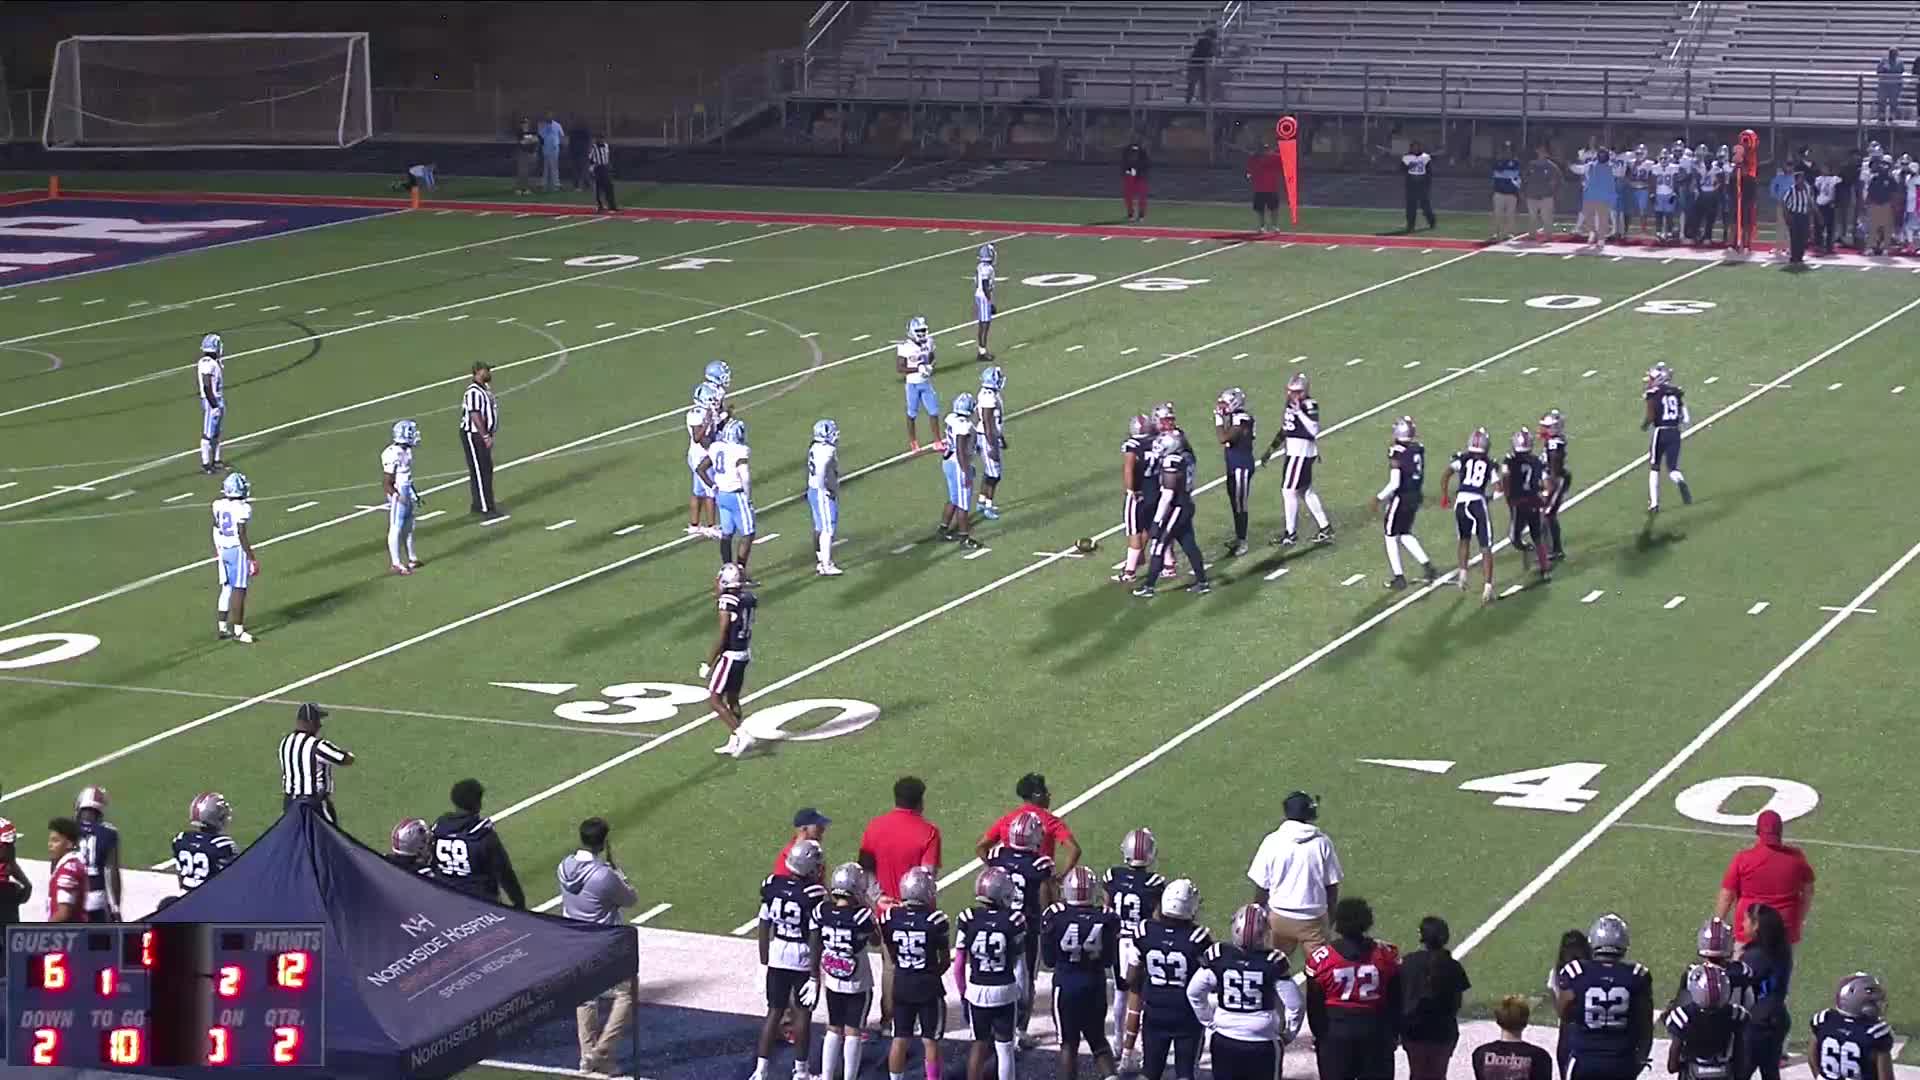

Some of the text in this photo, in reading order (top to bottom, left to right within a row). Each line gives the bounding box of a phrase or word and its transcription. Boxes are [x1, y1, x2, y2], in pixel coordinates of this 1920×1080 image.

[1463, 459, 1488, 488] 18
[436, 839, 473, 876] 58
[367, 936, 449, 987] NORTHSIDE
[440, 911, 506, 943] HOSPITAL
[1059, 922, 1104, 963] 44
[1146, 949, 1189, 988] 63
[1333, 965, 1381, 1001] 72
[1222, 970, 1264, 1010] 65
[1584, 986, 1632, 1030] 62
[1484, 1052, 1532, 1070] Dodge
[1820, 1036, 1863, 1080] 66
